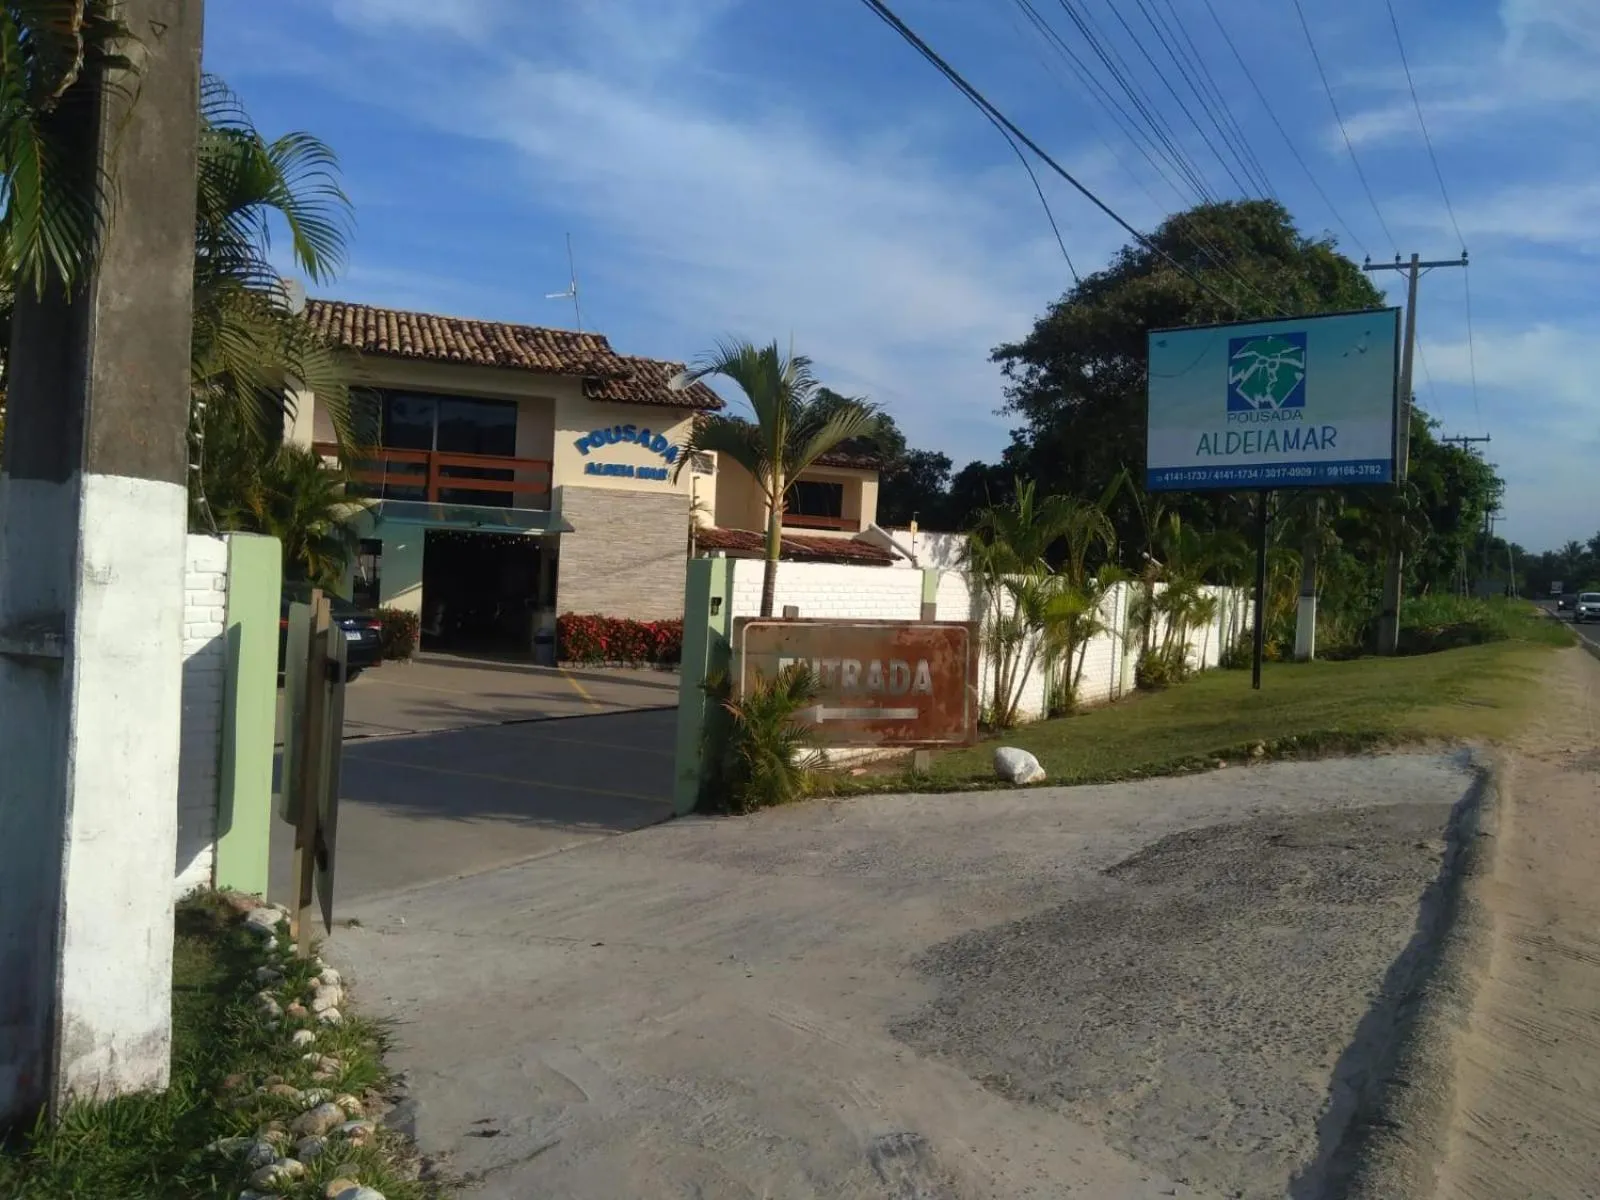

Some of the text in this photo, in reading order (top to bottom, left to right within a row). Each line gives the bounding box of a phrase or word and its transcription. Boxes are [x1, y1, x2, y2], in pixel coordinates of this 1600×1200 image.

[1227, 409, 1303, 423] POUSADA
[574, 424, 679, 464] POUSADA
[1196, 425, 1337, 455] ALDEIAMAR
